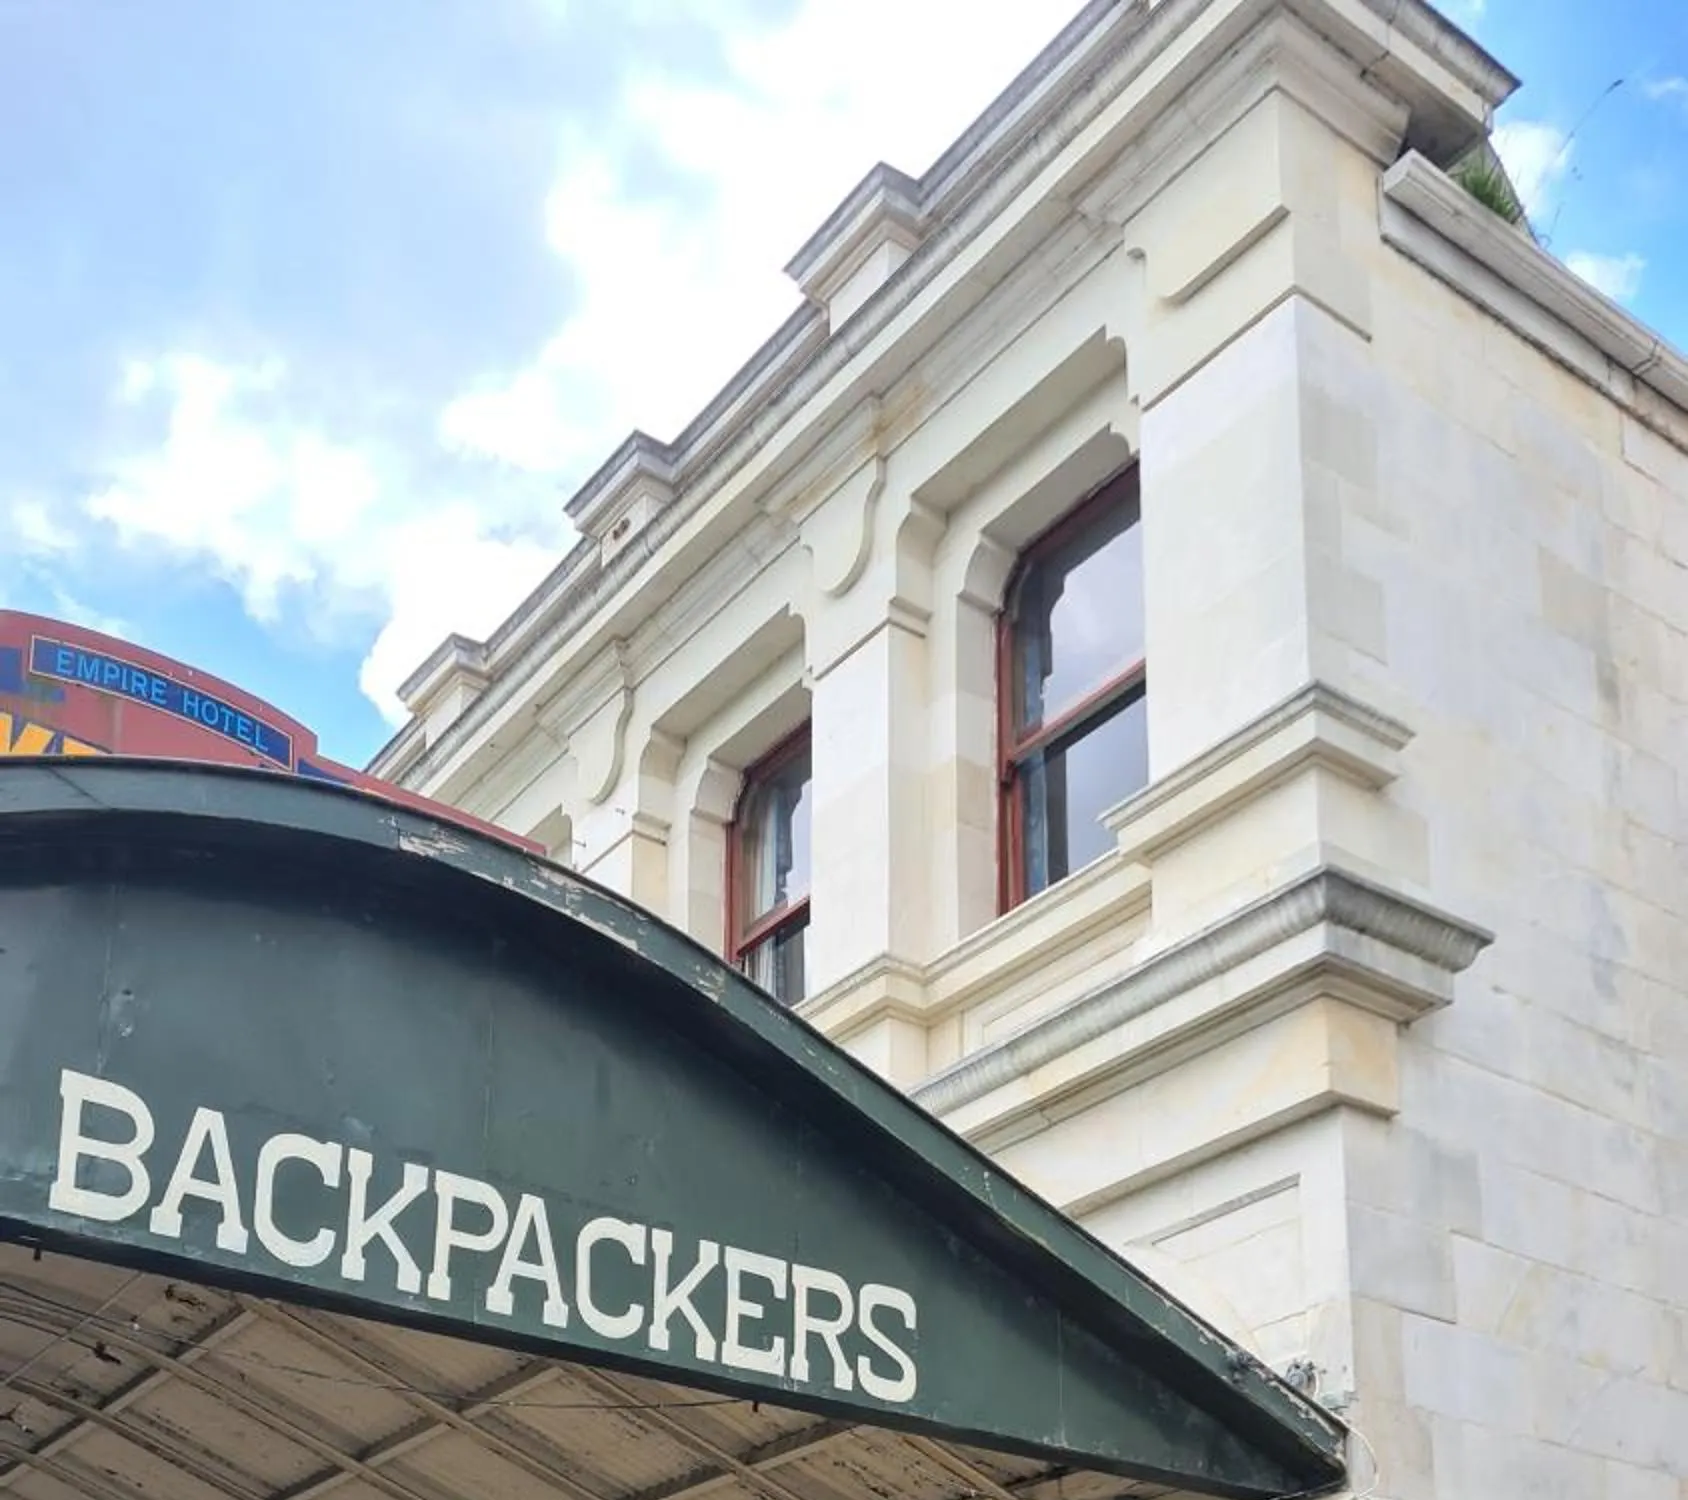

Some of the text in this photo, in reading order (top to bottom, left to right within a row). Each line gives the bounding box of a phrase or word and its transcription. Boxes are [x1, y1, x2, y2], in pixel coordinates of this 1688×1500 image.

[55, 649, 269, 751] EMPIRE HOTEL
[48, 1068, 918, 1402] BACKPACKERS
